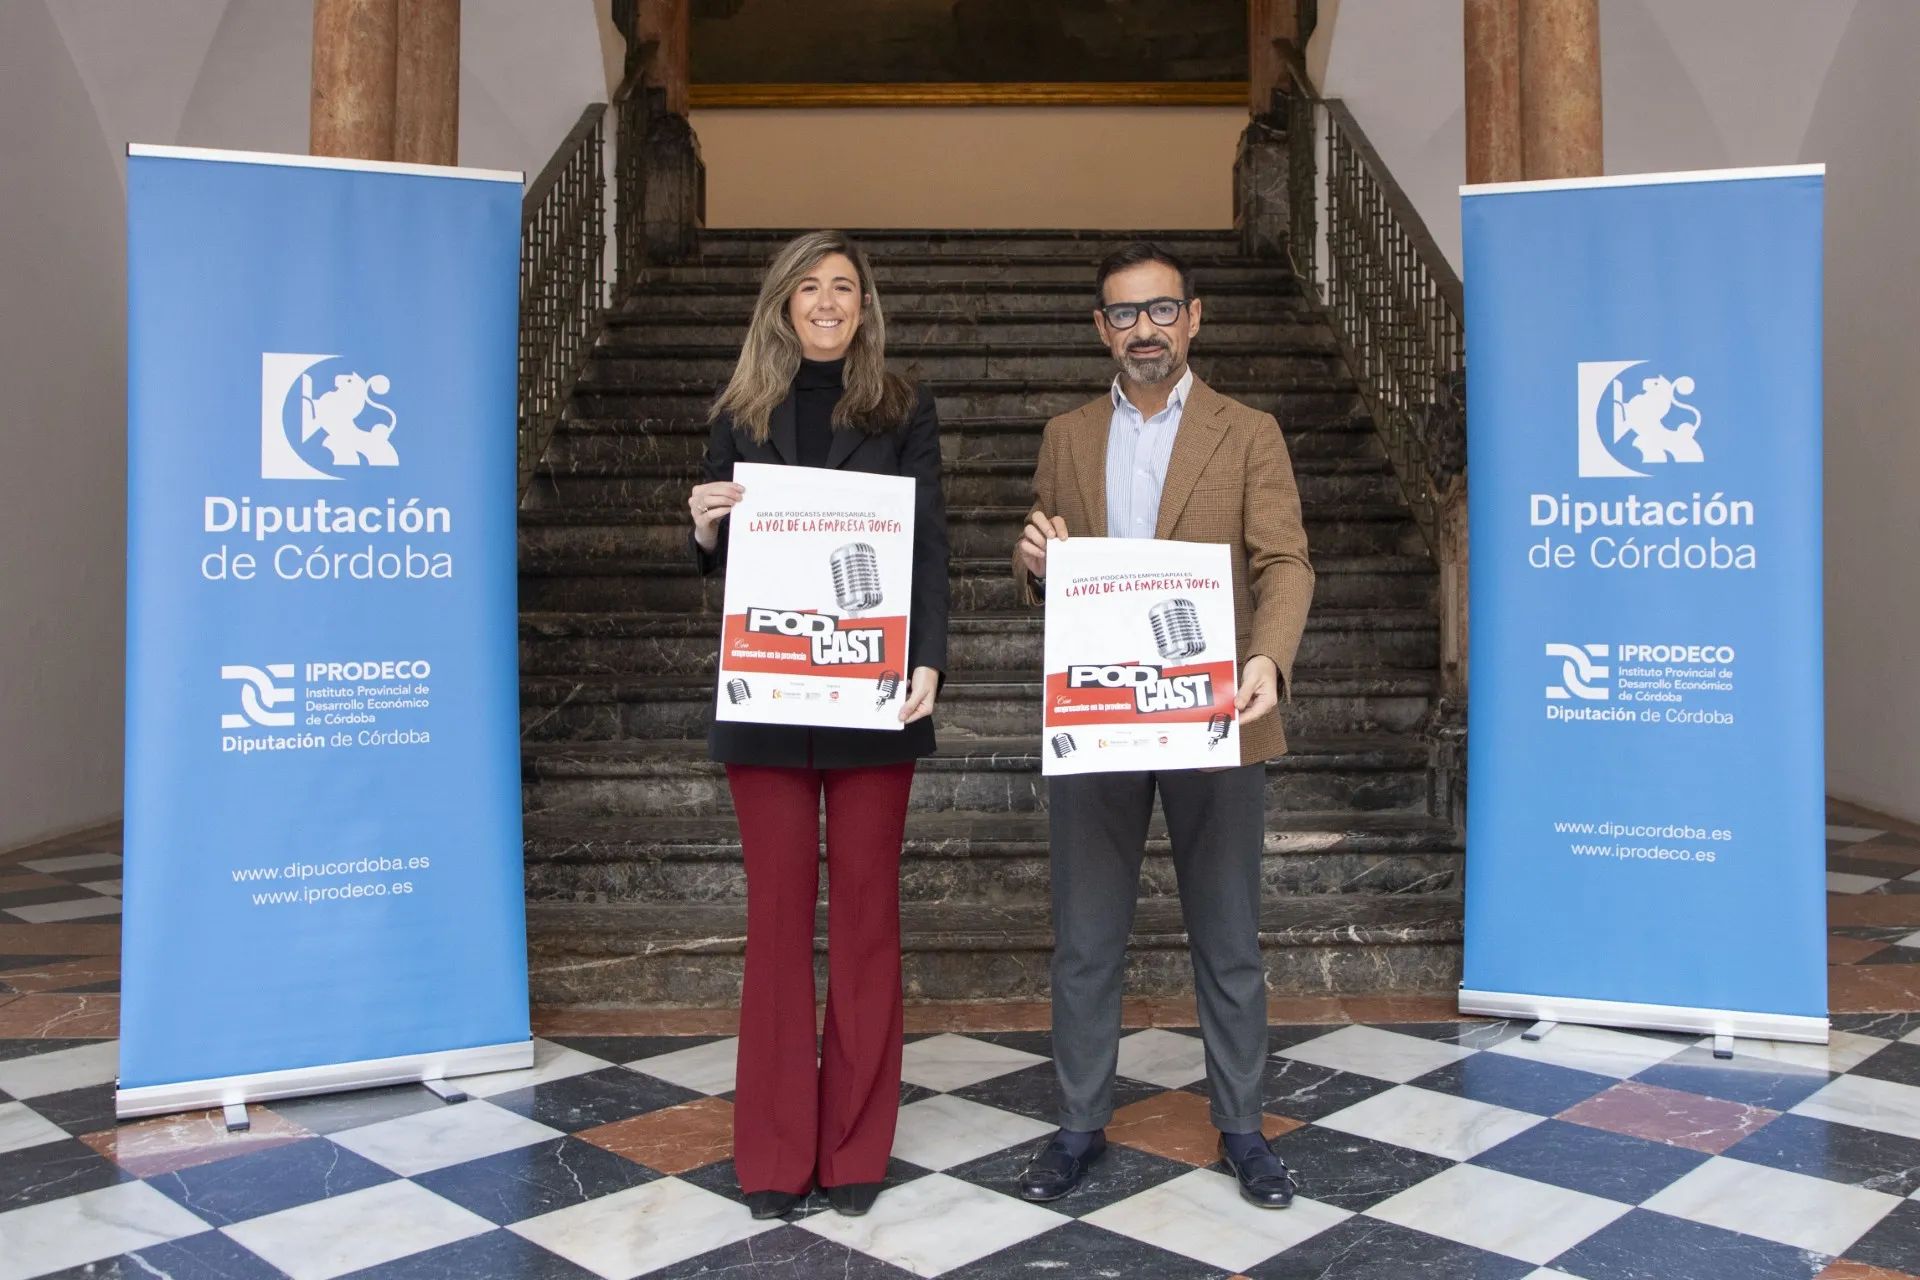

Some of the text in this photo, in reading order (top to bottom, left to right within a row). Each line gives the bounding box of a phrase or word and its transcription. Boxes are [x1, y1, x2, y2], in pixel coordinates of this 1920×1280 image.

[204, 496, 451, 541] Diputación
[822, 511, 876, 519] EMPRESARIALES
[1530, 492, 1754, 534] Diputación
[750, 519, 762, 532] LA
[765, 519, 784, 532] VOZ
[787, 519, 799, 532] DE
[802, 519, 816, 532] LA
[818, 519, 865, 533] EMPRESA
[201, 544, 452, 580] de Córdoba
[1528, 536, 1756, 569] de Córdoba
[1066, 584, 1079, 597] LA
[1082, 583, 1100, 595] VOZ
[1104, 581, 1116, 593] DE
[1119, 581, 1132, 592] LA
[1135, 578, 1183, 591] EMPRESA
[1618, 644, 1735, 664] IPRODECO
[305, 660, 431, 682] IPRODECO
[1618, 667, 1733, 679] Instituto Provincial de
[305, 683, 430, 698] Instituto Provincial de
[1618, 678, 1733, 691] Desarrollo Económico
[305, 697, 430, 712] Desarrollo Económico
[1618, 690, 1682, 702] de Córdoba
[305, 711, 376, 726] de Córdoba
[1546, 705, 1734, 725] Diputación de Córdoba
[222, 728, 430, 754] Diputación de Córdoba
[1554, 821, 1732, 841] www.dipucordoba.es
[1571, 844, 1716, 863] www.iprodeco.es
[231, 855, 430, 884] www.dipucordoba.es
[252, 878, 413, 906] www.iprodeco.es
